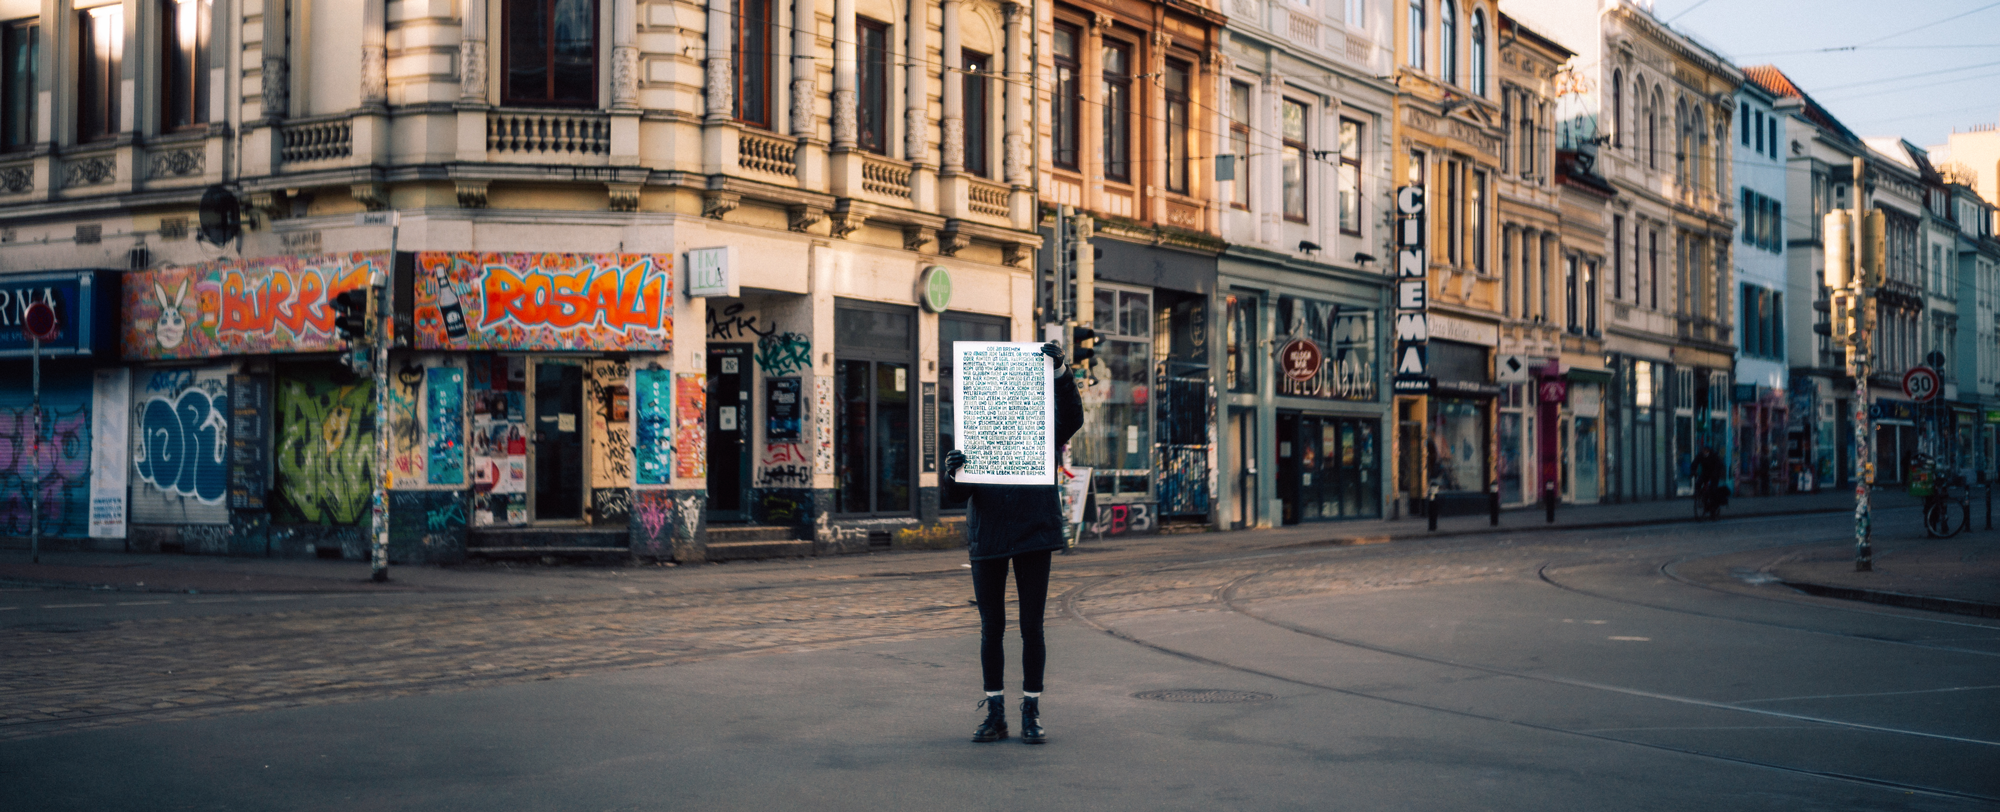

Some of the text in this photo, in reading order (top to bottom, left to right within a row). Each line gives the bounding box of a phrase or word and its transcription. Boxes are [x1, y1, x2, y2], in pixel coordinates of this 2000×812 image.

[1397, 186, 1426, 374] CINEMA
[1395, 379, 1430, 389] CINEMA
[1909, 376, 1931, 393] 30
